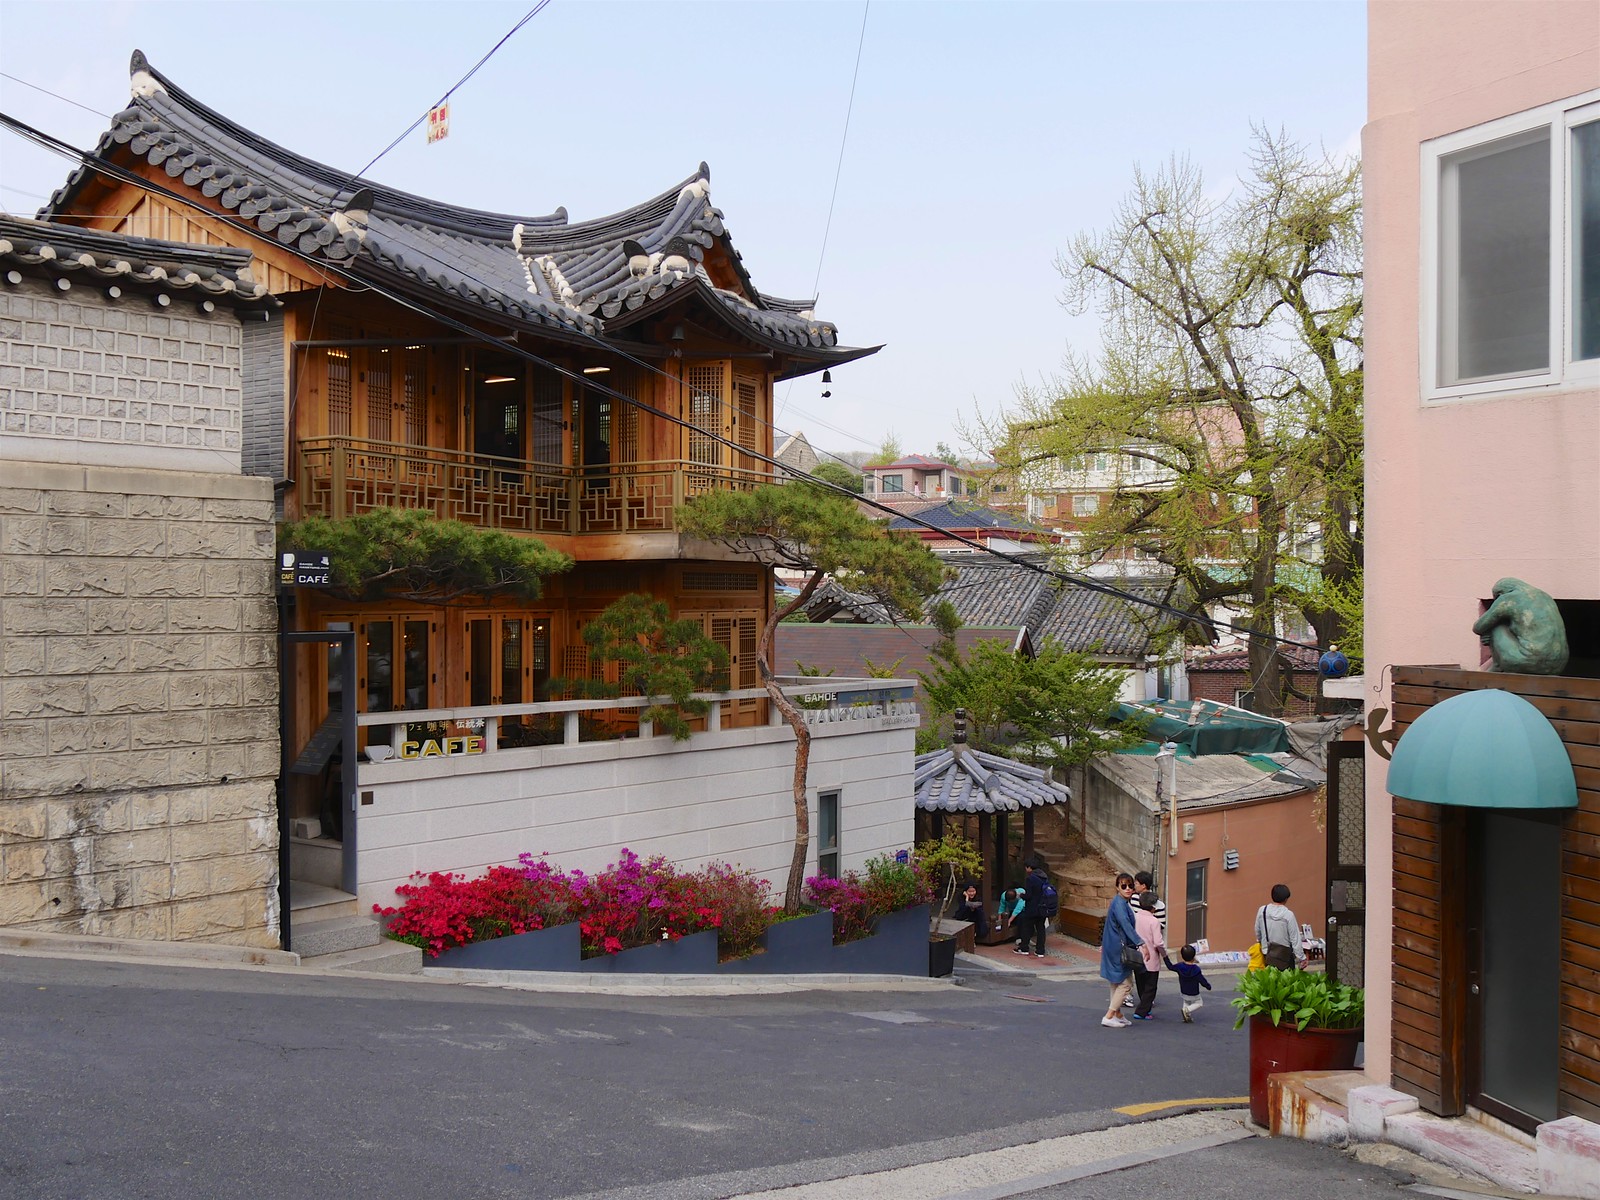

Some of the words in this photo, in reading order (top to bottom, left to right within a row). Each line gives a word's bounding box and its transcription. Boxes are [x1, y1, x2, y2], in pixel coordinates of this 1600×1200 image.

[298, 573, 329, 584] CAFÉ
[804, 692, 837, 703] GAHOE
[401, 735, 483, 759] CAFE
